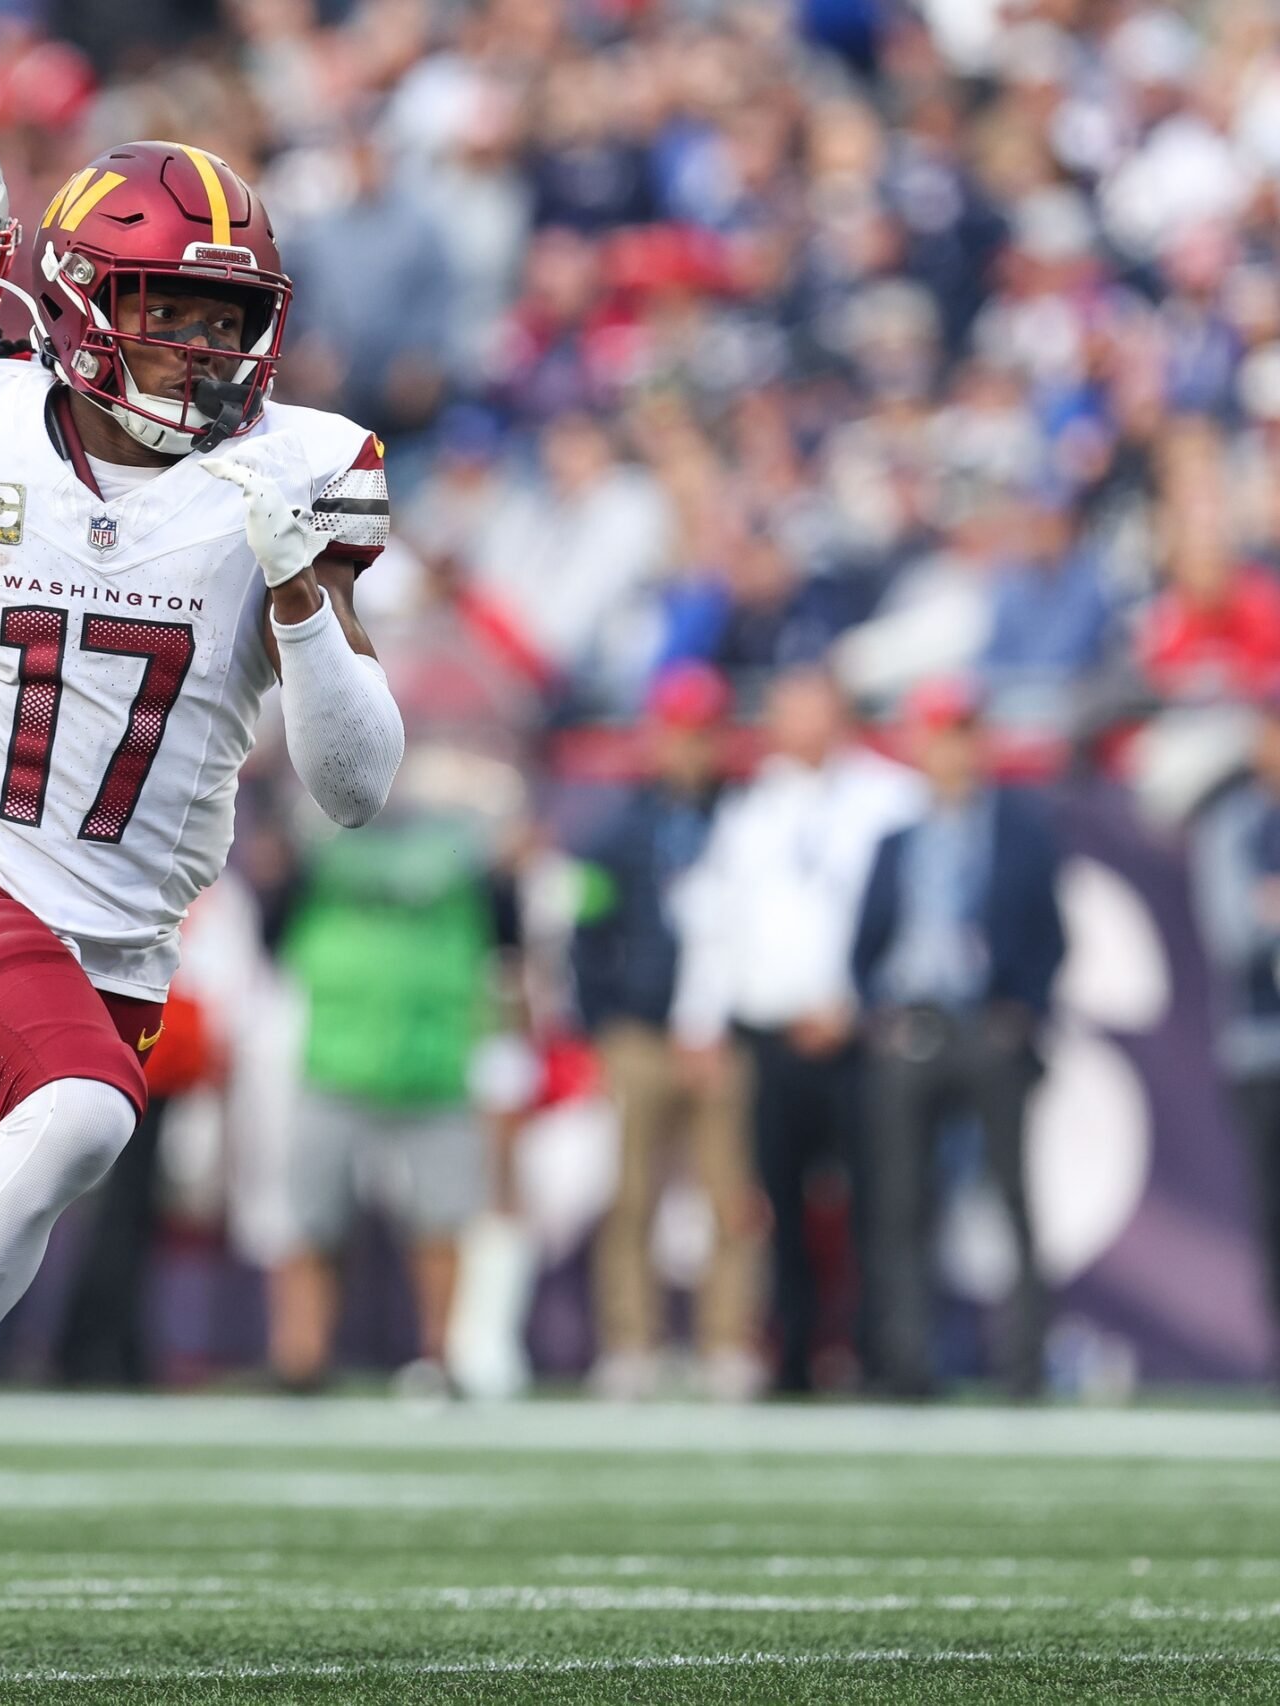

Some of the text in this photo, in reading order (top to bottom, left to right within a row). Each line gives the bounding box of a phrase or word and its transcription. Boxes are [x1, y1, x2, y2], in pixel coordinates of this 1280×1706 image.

[195, 247, 252, 266] COMMANDERS
[92, 530, 114, 546] NFL
[3, 575, 204, 611] WASHINGTON
